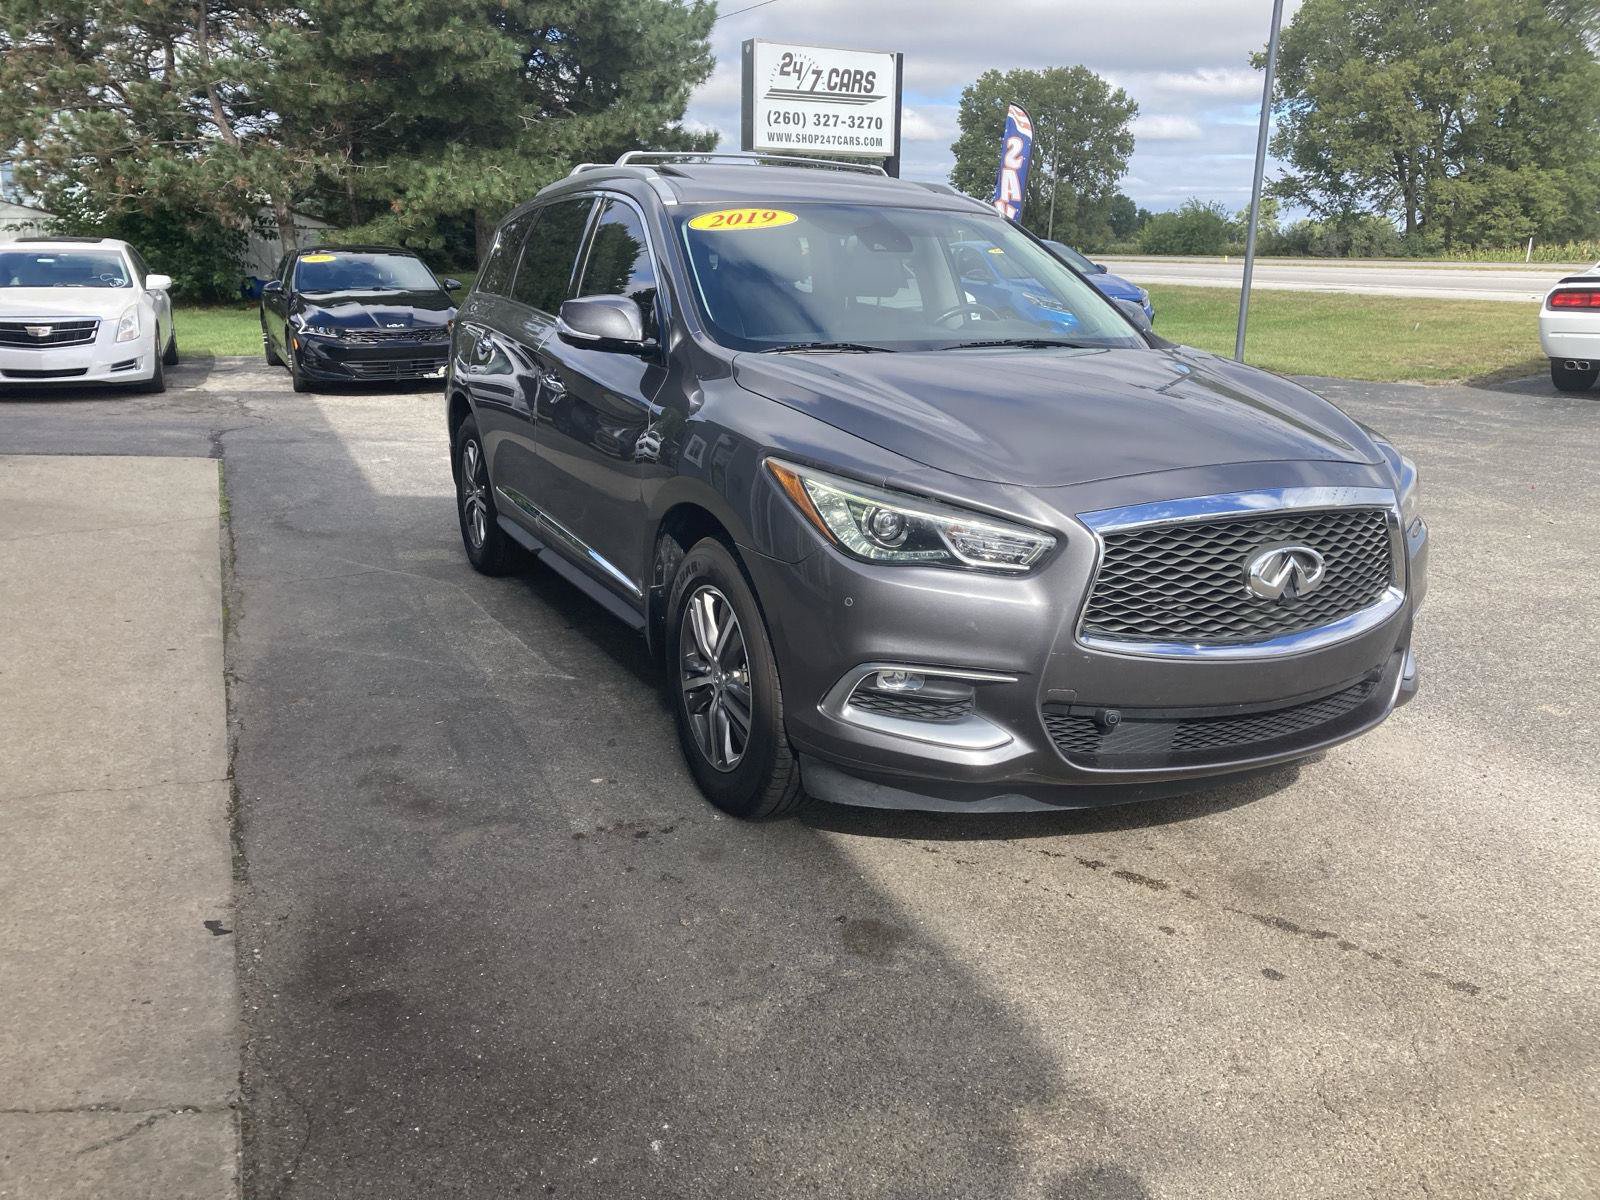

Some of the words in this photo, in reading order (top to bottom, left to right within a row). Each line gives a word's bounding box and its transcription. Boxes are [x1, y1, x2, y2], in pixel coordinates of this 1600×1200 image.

[779, 52, 824, 93] 24/7
[826, 67, 877, 94] CARS
[766, 110, 807, 129] (260)
[813, 113, 883, 130] 327-3270
[766, 132, 883, 147] WWW.SHOP247CARS.COM
[708, 211, 778, 228] 2019
